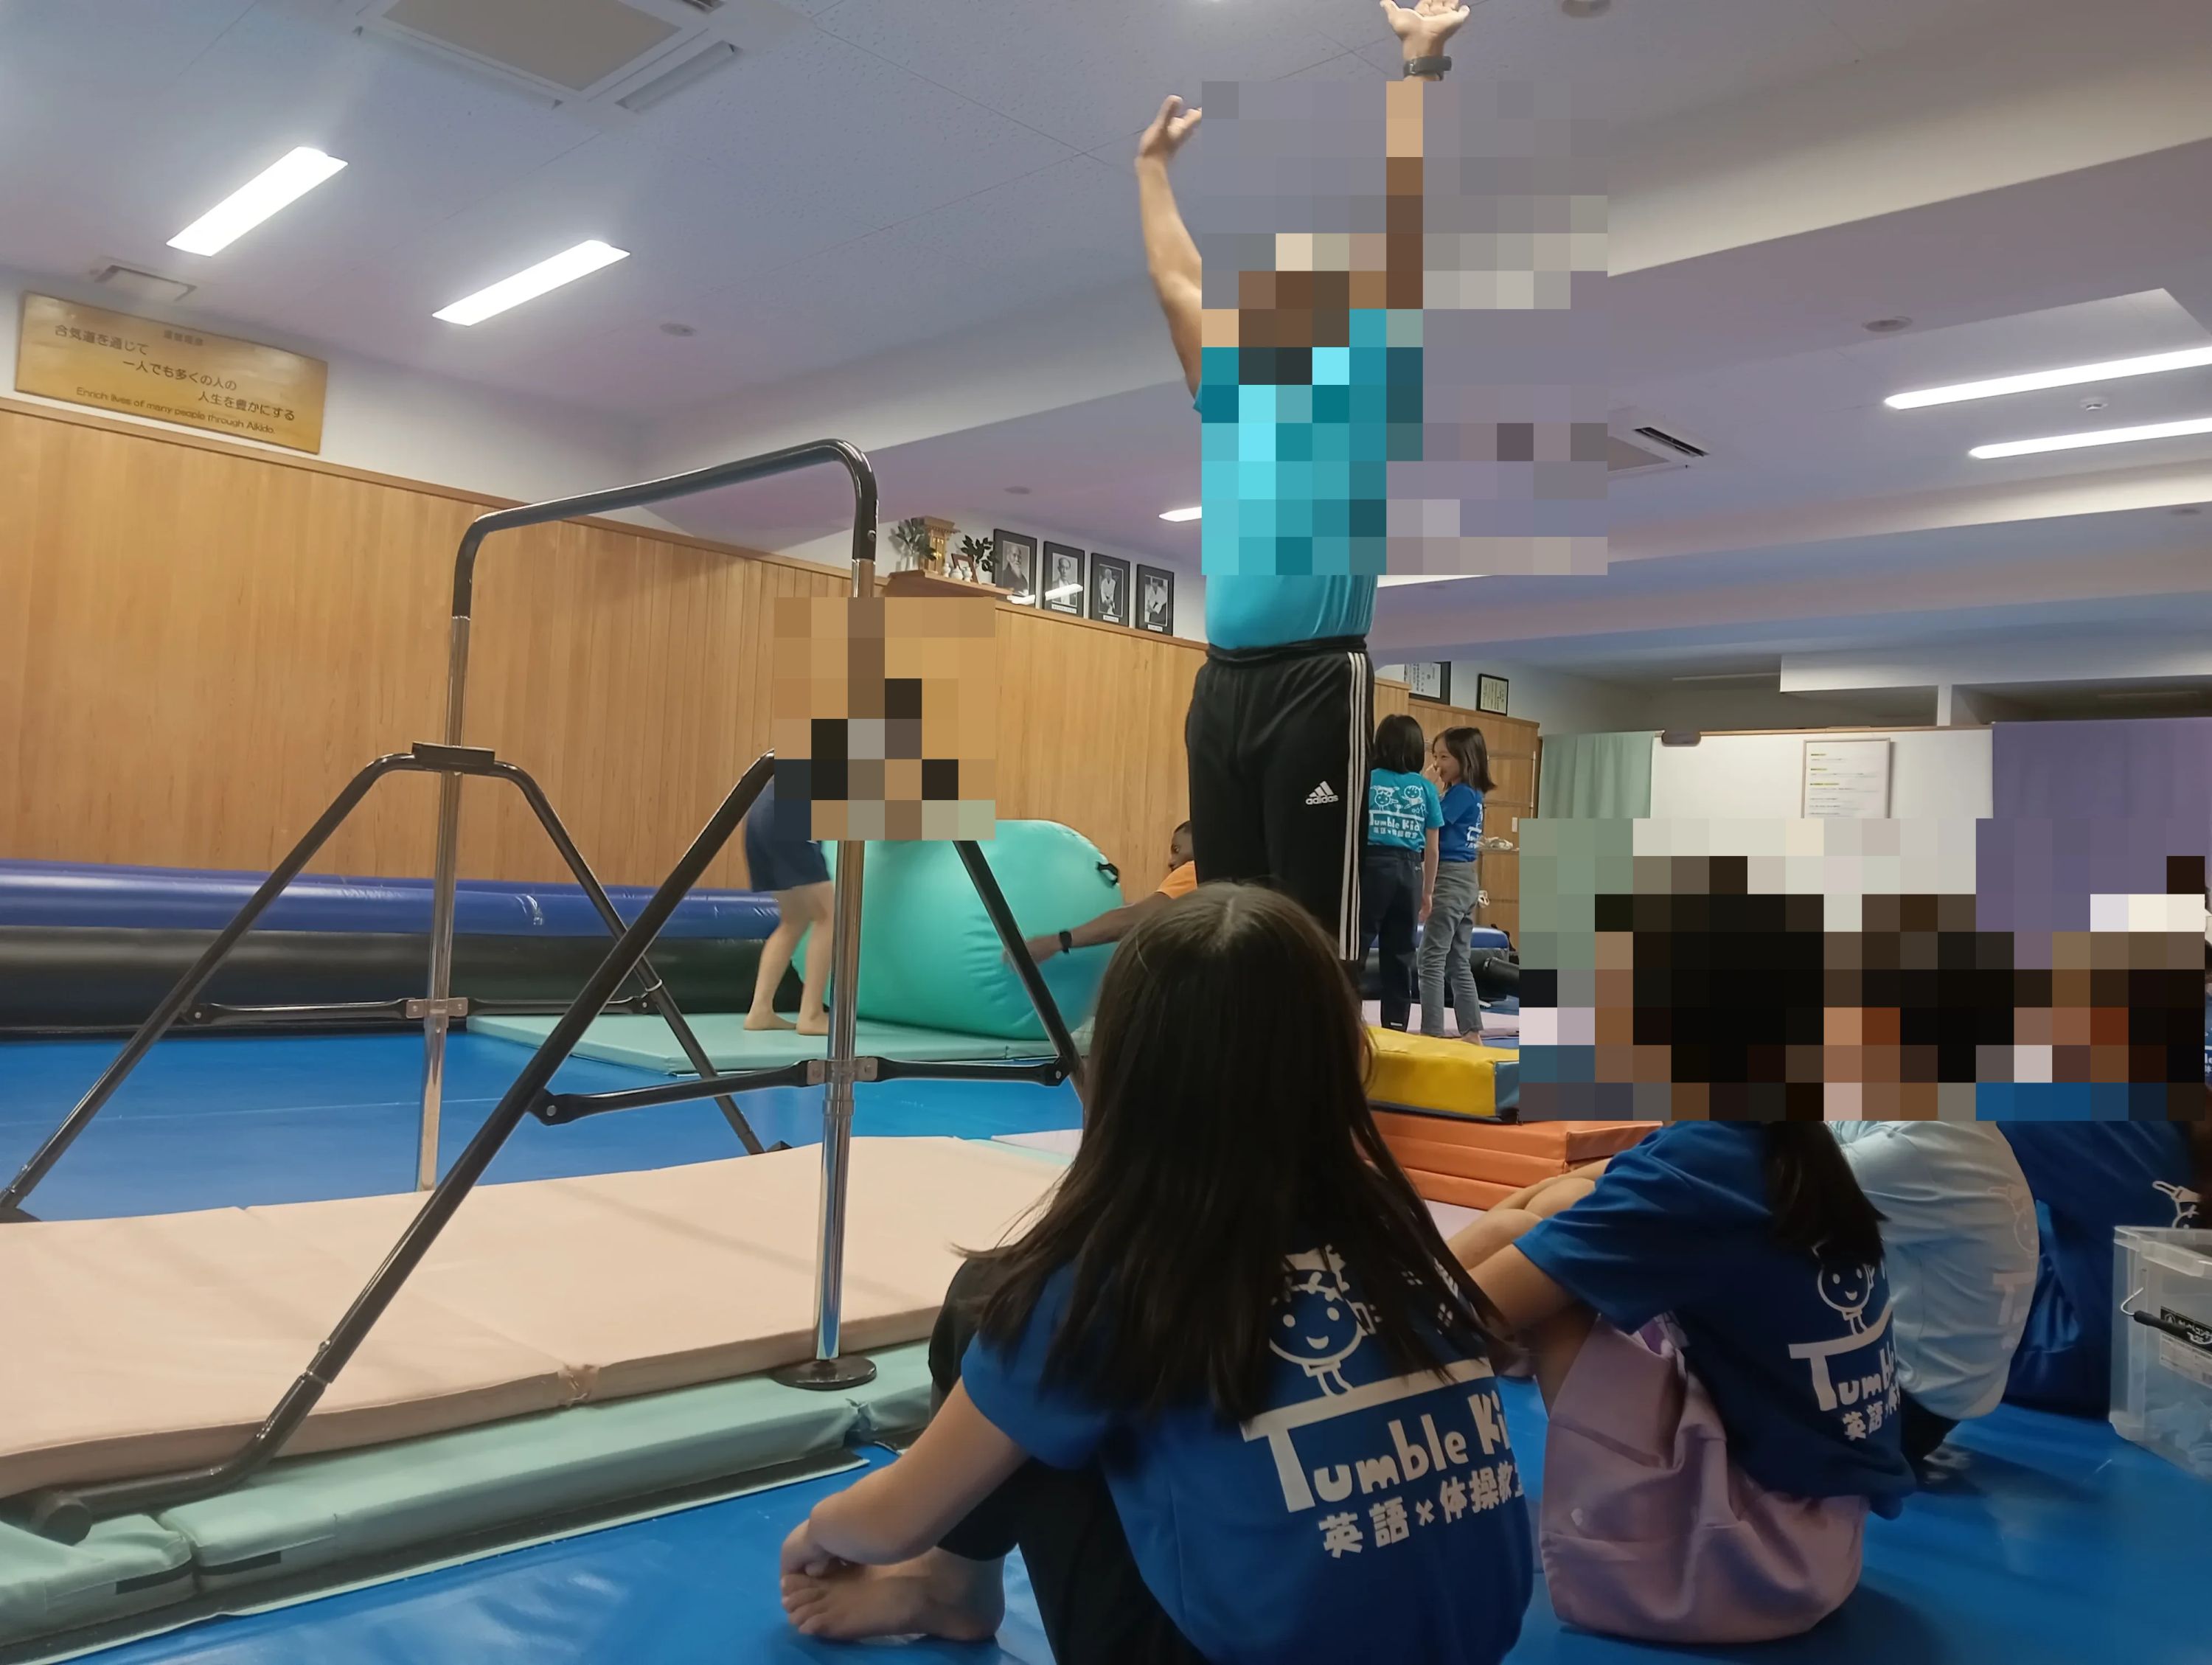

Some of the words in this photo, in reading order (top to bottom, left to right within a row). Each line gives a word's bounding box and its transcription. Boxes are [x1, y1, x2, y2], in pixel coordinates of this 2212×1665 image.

[55, 324, 149, 355] 合気道を通じて
[122, 359, 237, 392] 一人でも多くの人の
[76, 386, 108, 401] Enrich
[111, 393, 131, 406] lives
[133, 398, 145, 409] of
[147, 402, 172, 414] many
[174, 408, 206, 422] people
[208, 413, 244, 429] through
[198, 391, 296, 421] 人生を豊かにする
[1306, 795, 1339, 805] adidas
[1239, 1360, 1472, 1513] Tumble
[1467, 1389, 1512, 1456] Ki
